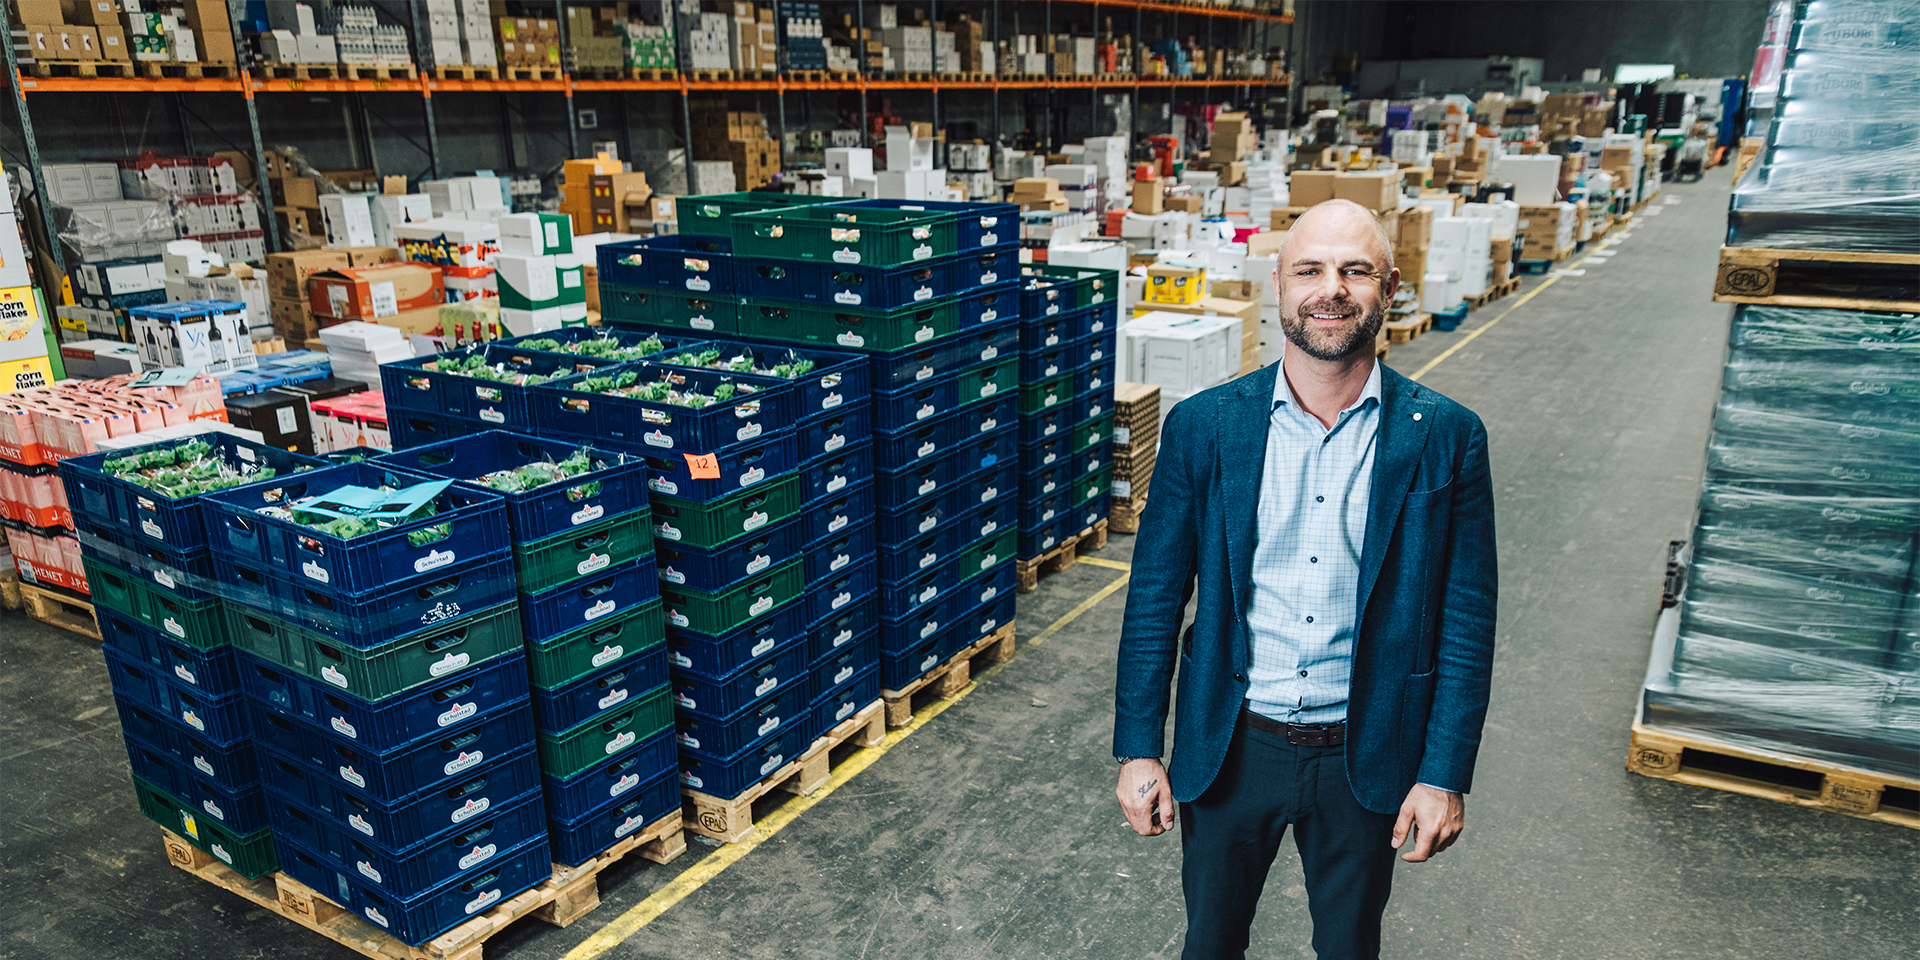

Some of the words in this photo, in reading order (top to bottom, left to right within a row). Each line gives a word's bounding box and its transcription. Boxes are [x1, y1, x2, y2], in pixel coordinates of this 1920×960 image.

[15, 371, 42, 382] Corn
[16, 379, 45, 390] flakes
[1850, 382, 1890, 396] Carlsberg
[1832, 466, 1870, 481] Carlsberg
[1822, 508, 1861, 522] Carlsberg
[583, 558, 606, 569] Schulstad
[444, 707, 471, 721] Schulstad
[451, 755, 478, 770] Schulstad
[458, 802, 484, 818] Schulstad
[704, 816, 724, 830] EPAL
[465, 848, 491, 864] Schulstad
